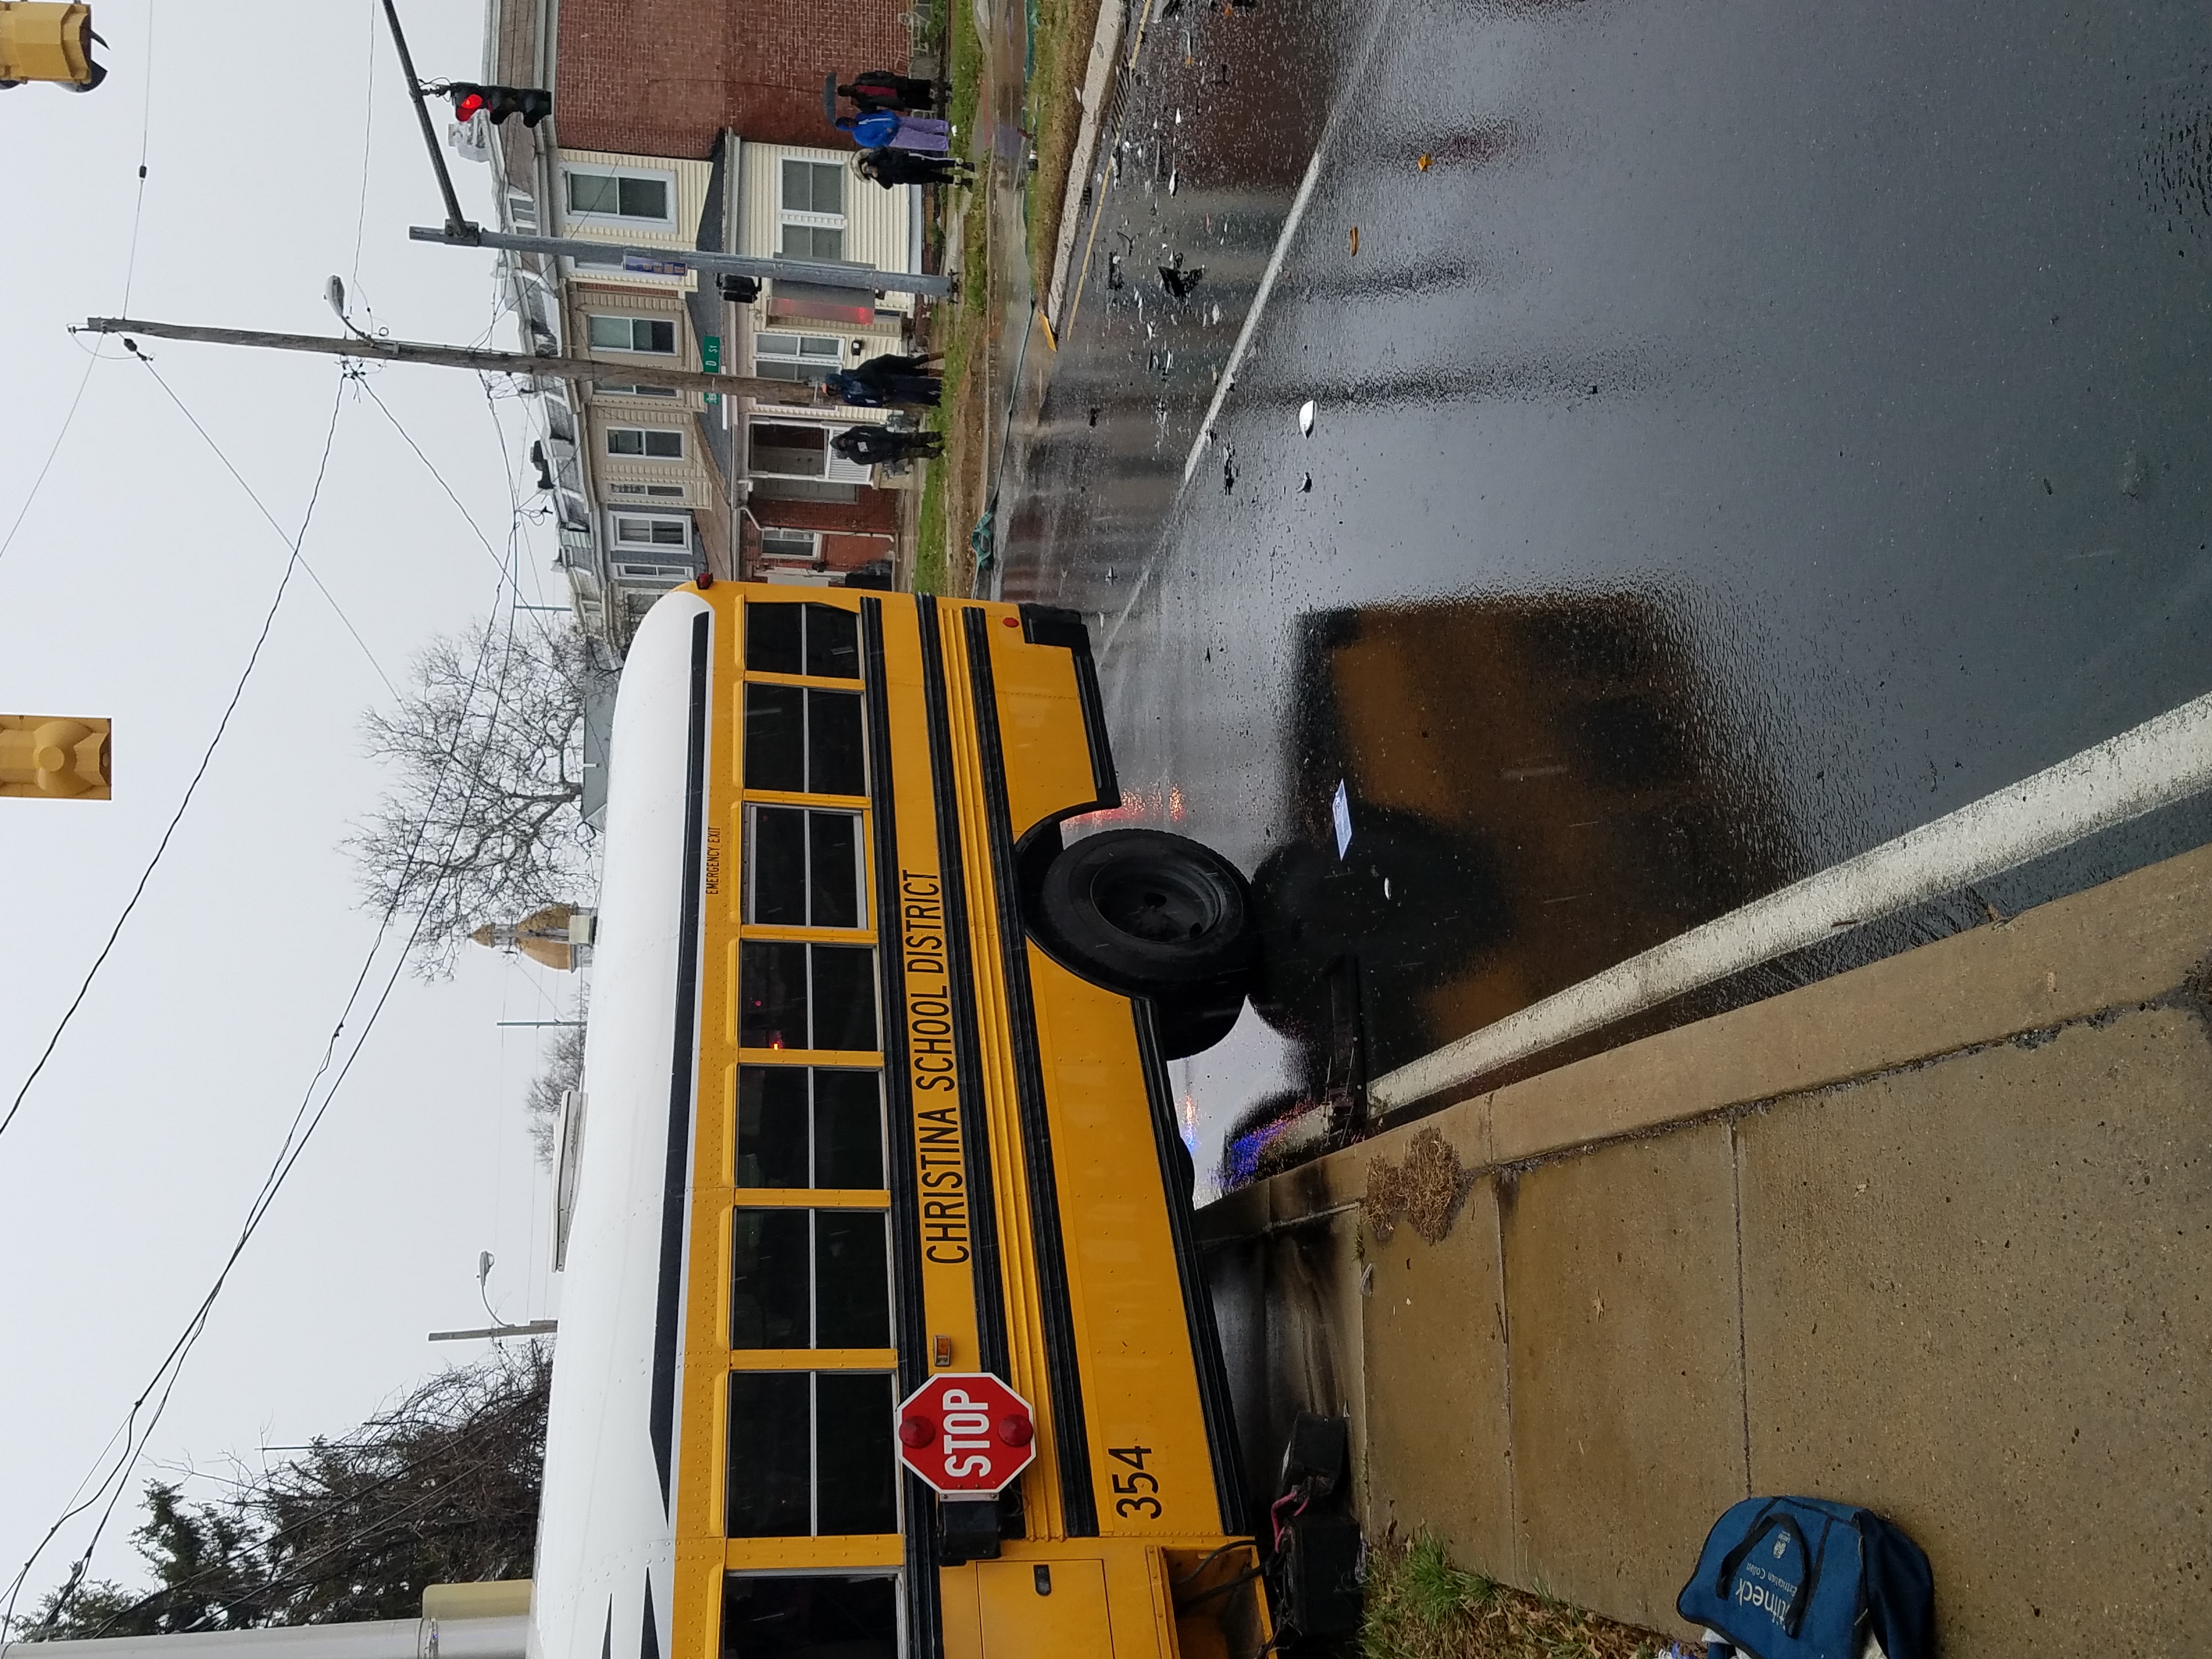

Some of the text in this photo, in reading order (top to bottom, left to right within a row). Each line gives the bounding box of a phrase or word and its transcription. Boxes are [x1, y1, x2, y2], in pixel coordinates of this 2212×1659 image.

[706, 826, 720, 895] EMERGENCY EXIT
[902, 869, 970, 1265] CHRISTINA SCHOOL DISTRICT
[942, 1388, 992, 1477] STOP
[1108, 1446, 1163, 1520] 354
